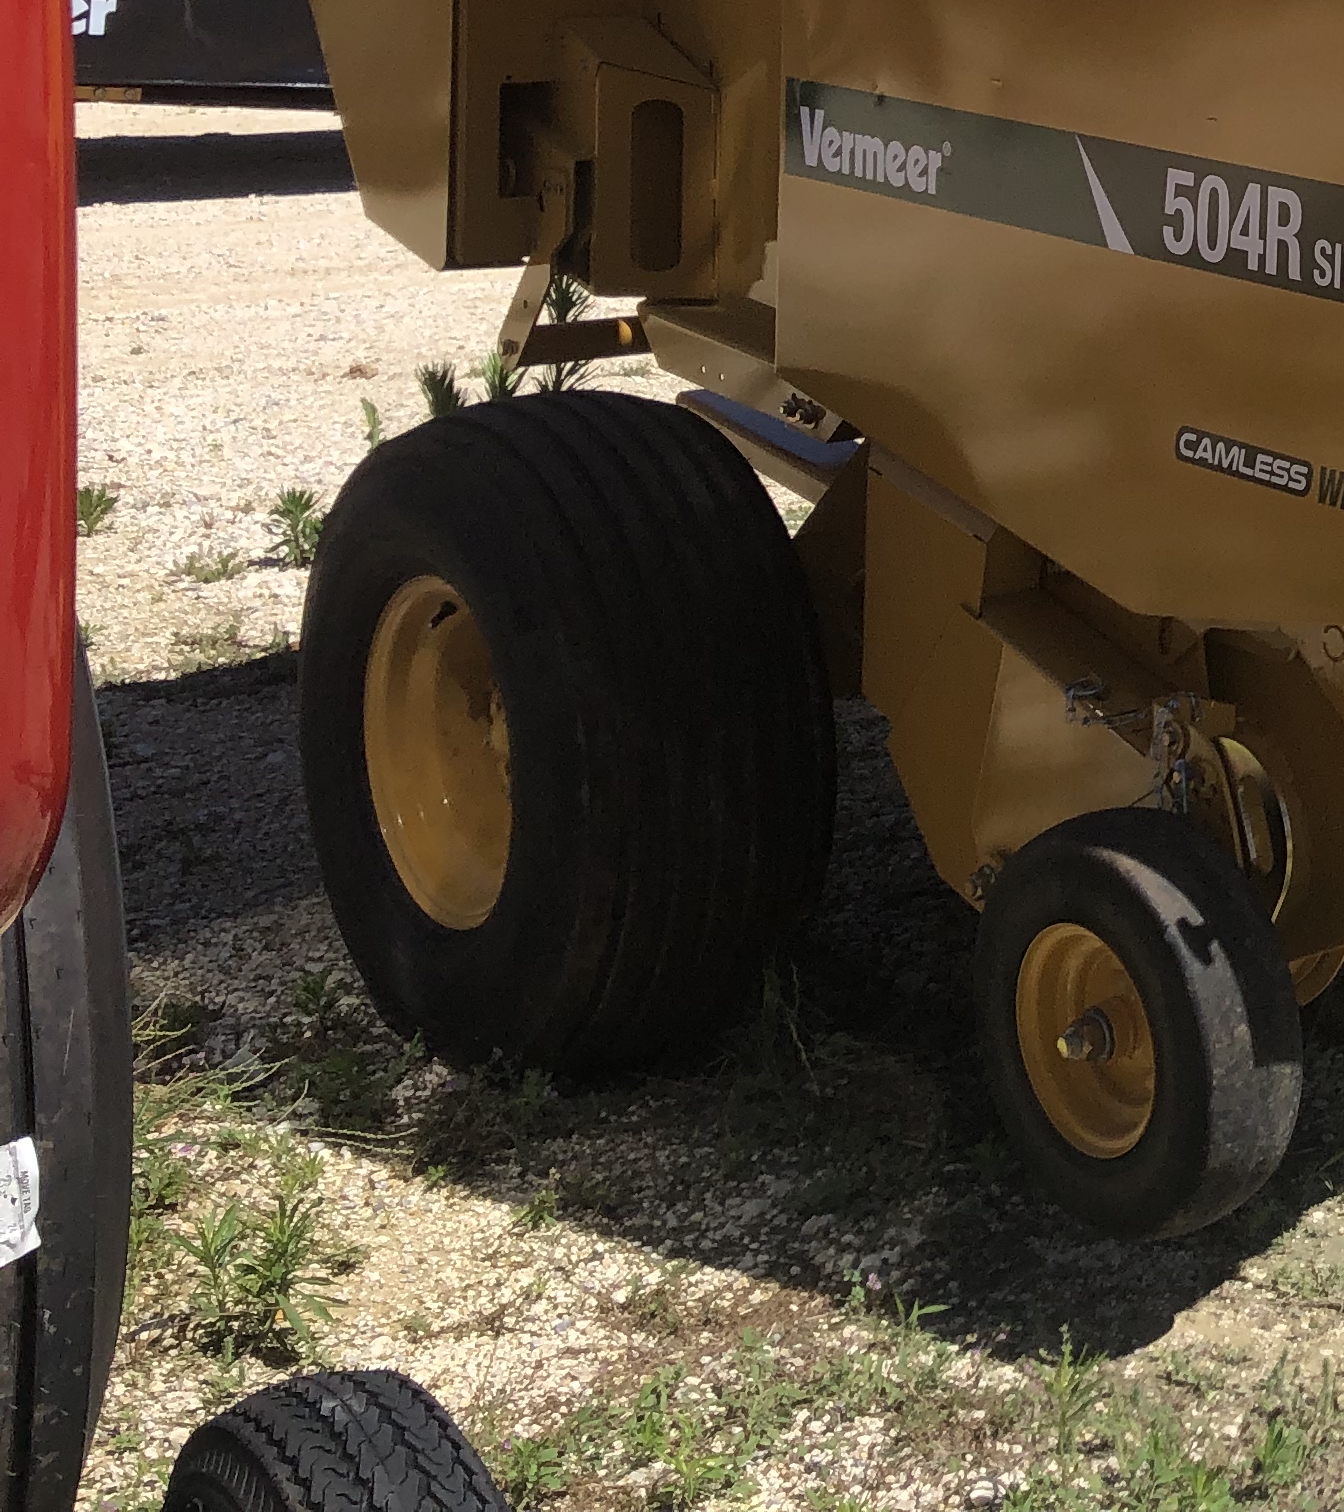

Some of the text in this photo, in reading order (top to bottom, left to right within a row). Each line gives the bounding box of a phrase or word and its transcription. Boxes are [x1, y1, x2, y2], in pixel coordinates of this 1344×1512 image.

[799, 105, 943, 196] Vermeer
[1162, 166, 1304, 281] 504R
[1178, 431, 1310, 492] CAMLESS
